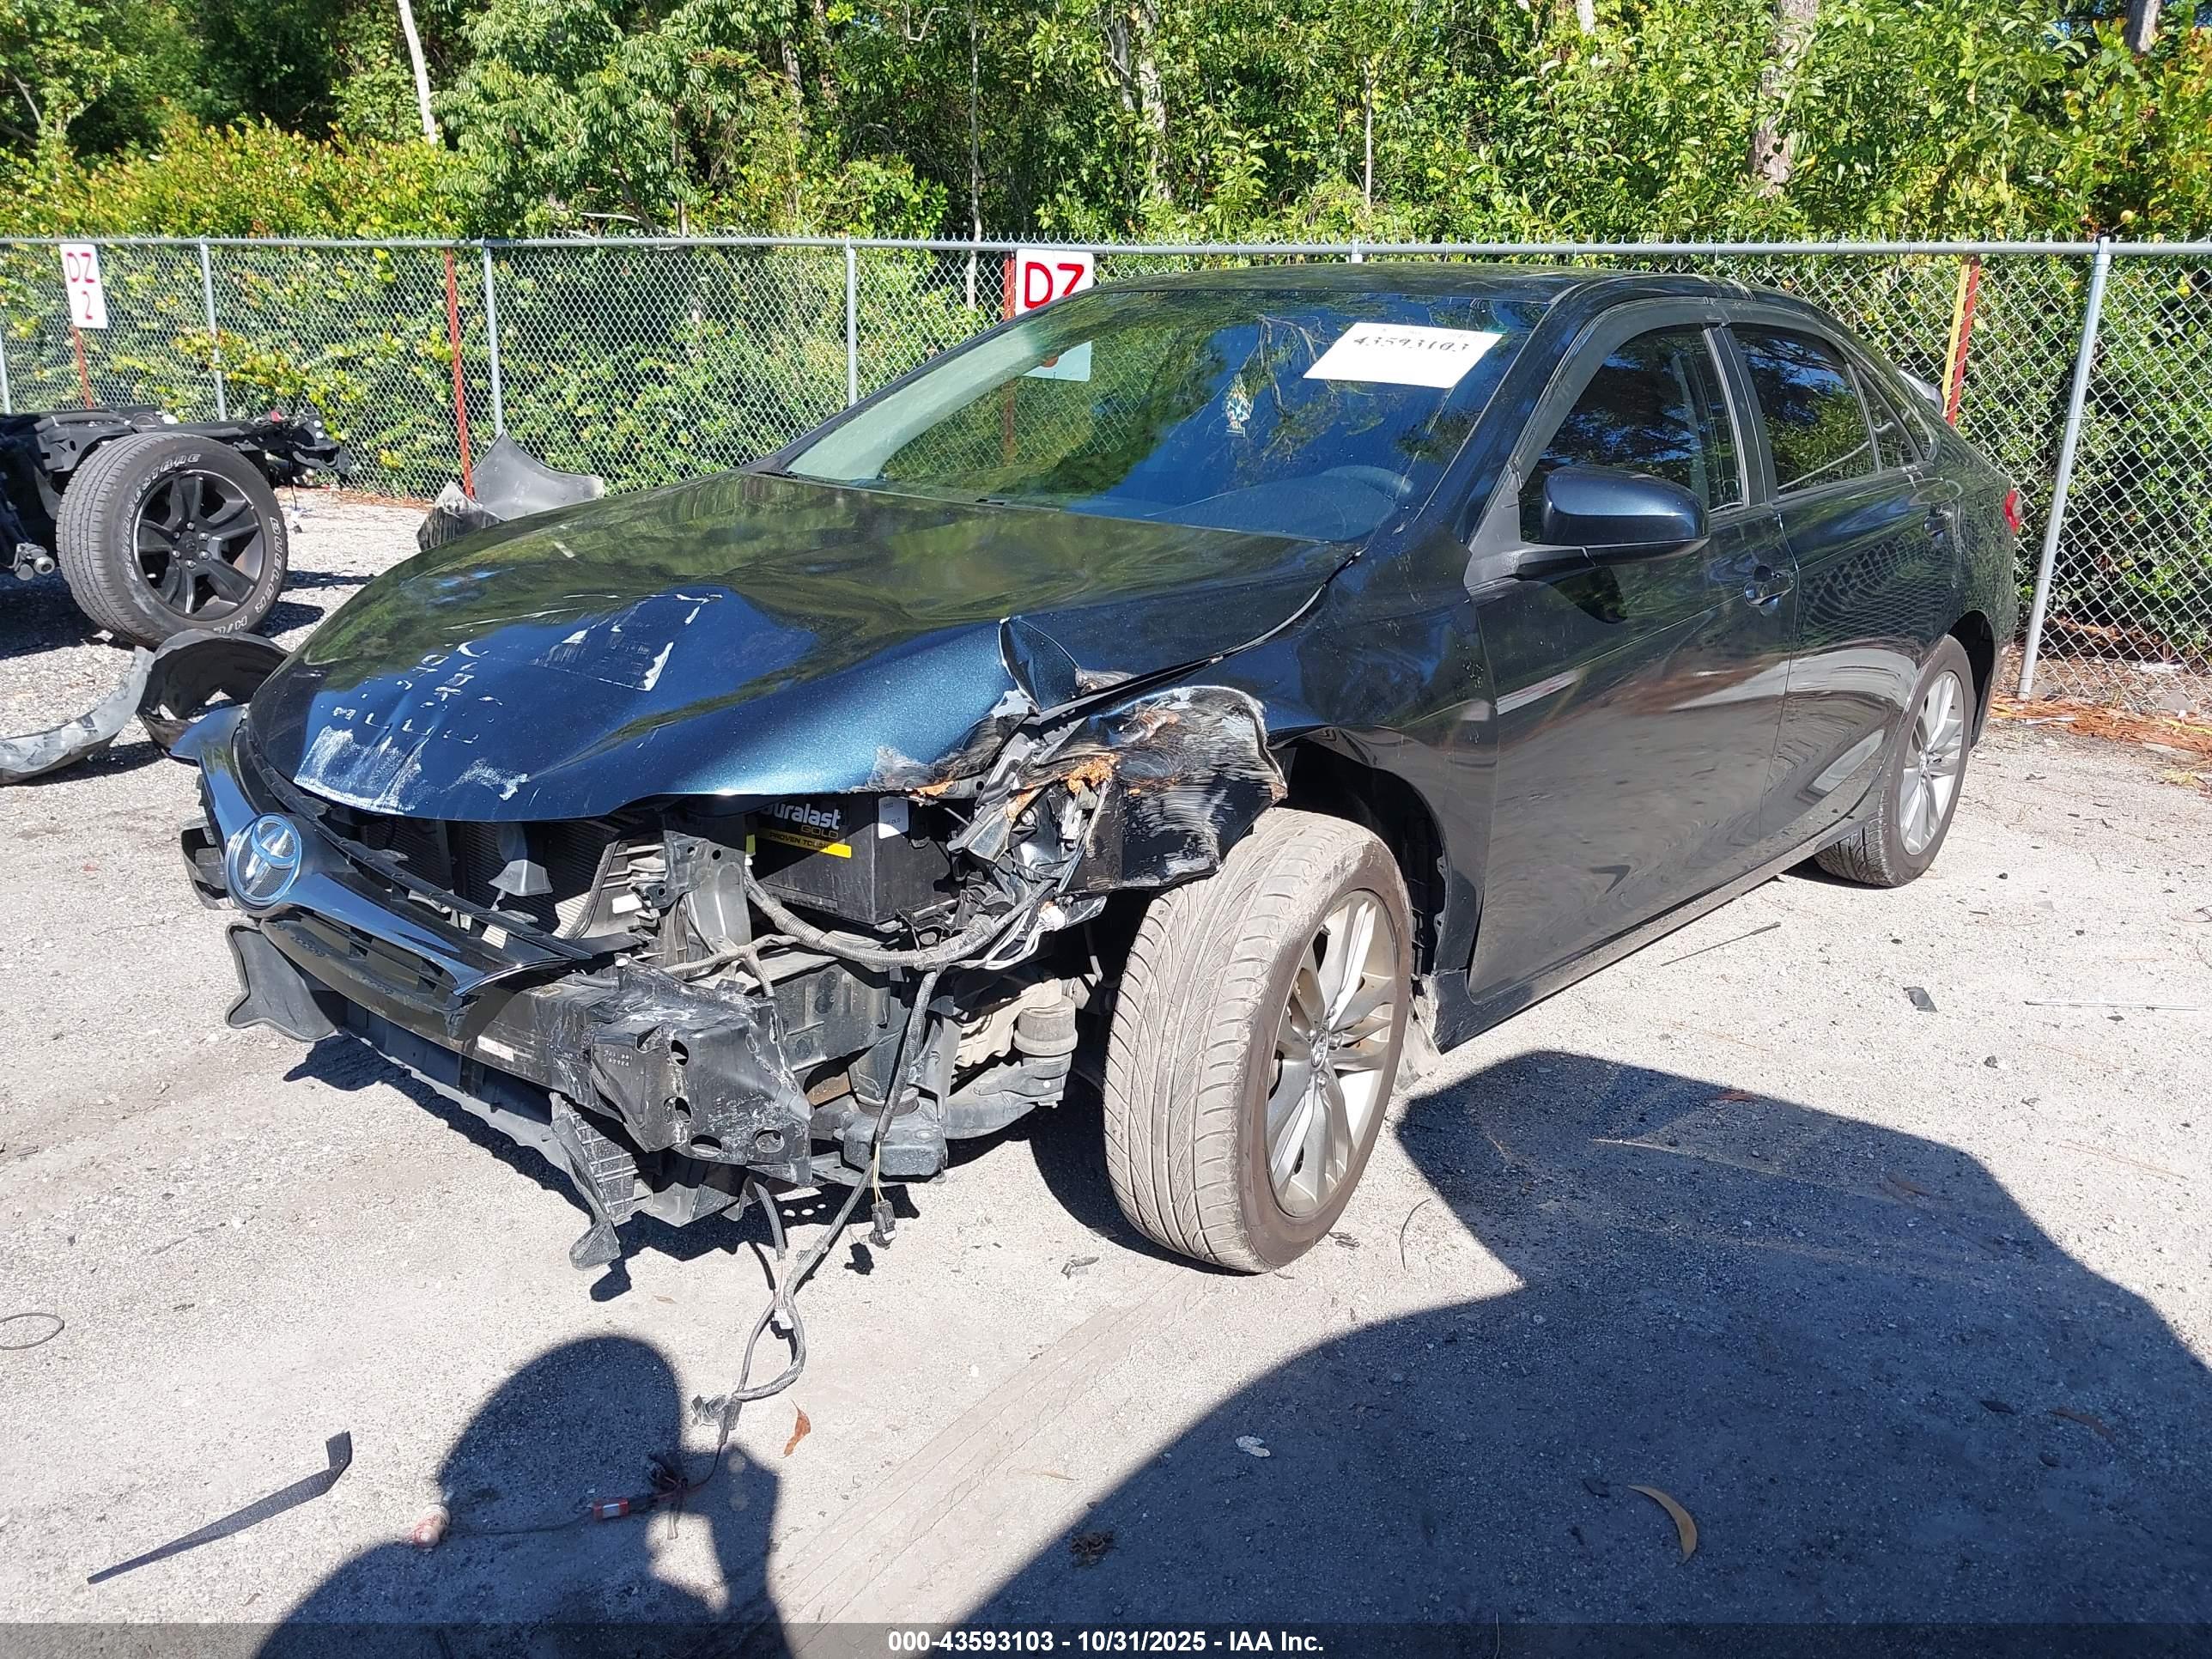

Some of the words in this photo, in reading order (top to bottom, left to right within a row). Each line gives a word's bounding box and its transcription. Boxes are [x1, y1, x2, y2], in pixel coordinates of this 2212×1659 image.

[66, 252, 95, 283] DZ
[82, 290, 94, 320] 2
[1353, 336, 1470, 353] 43593103
[254, 516, 283, 613] DUELER
[769, 830, 800, 844] PROVEN
[800, 824, 839, 840] GOLD
